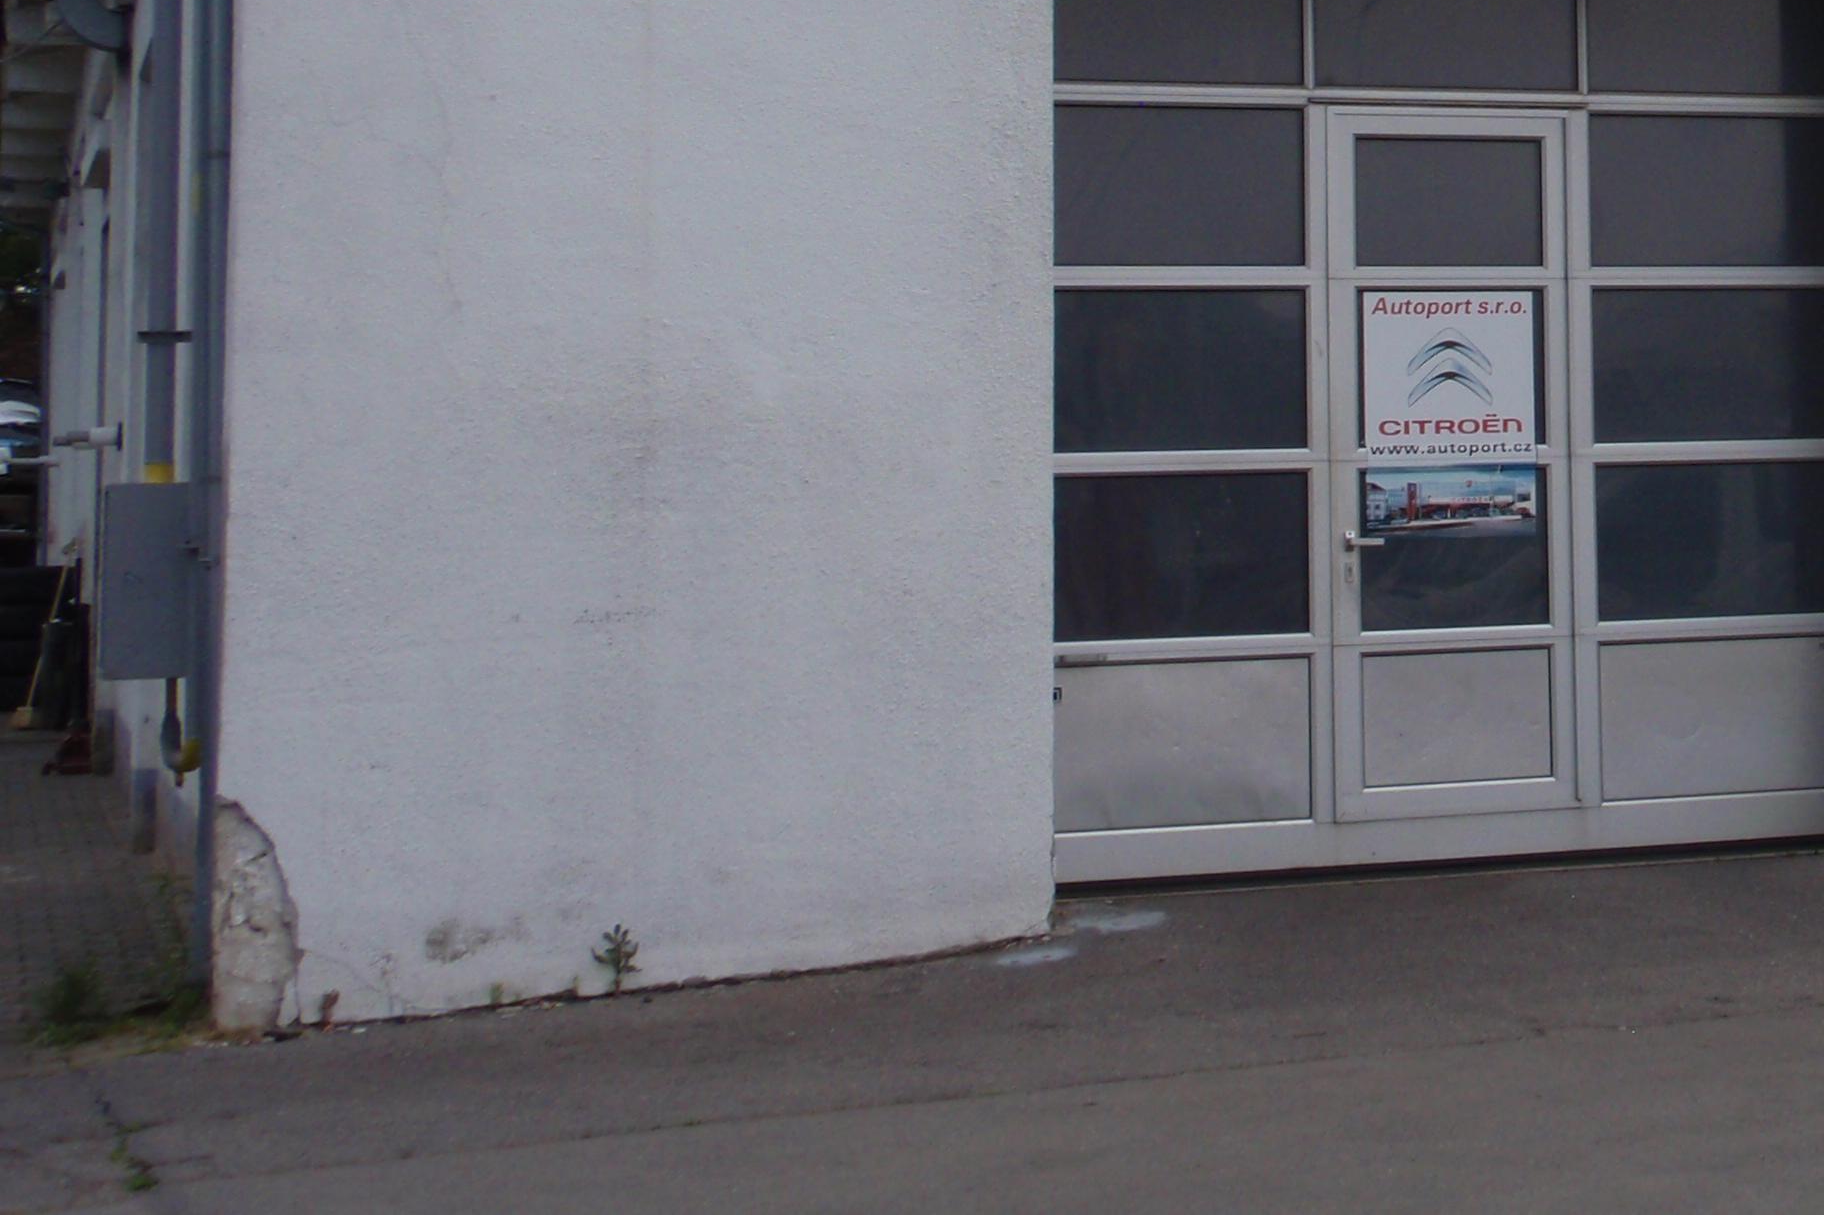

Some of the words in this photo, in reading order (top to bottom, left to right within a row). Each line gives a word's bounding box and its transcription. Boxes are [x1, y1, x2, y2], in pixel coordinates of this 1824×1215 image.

[1372, 298, 1472, 319] Autoport
[1478, 302, 1526, 314] s.r.o.
[1370, 442, 1532, 456] www.autoport.cz
